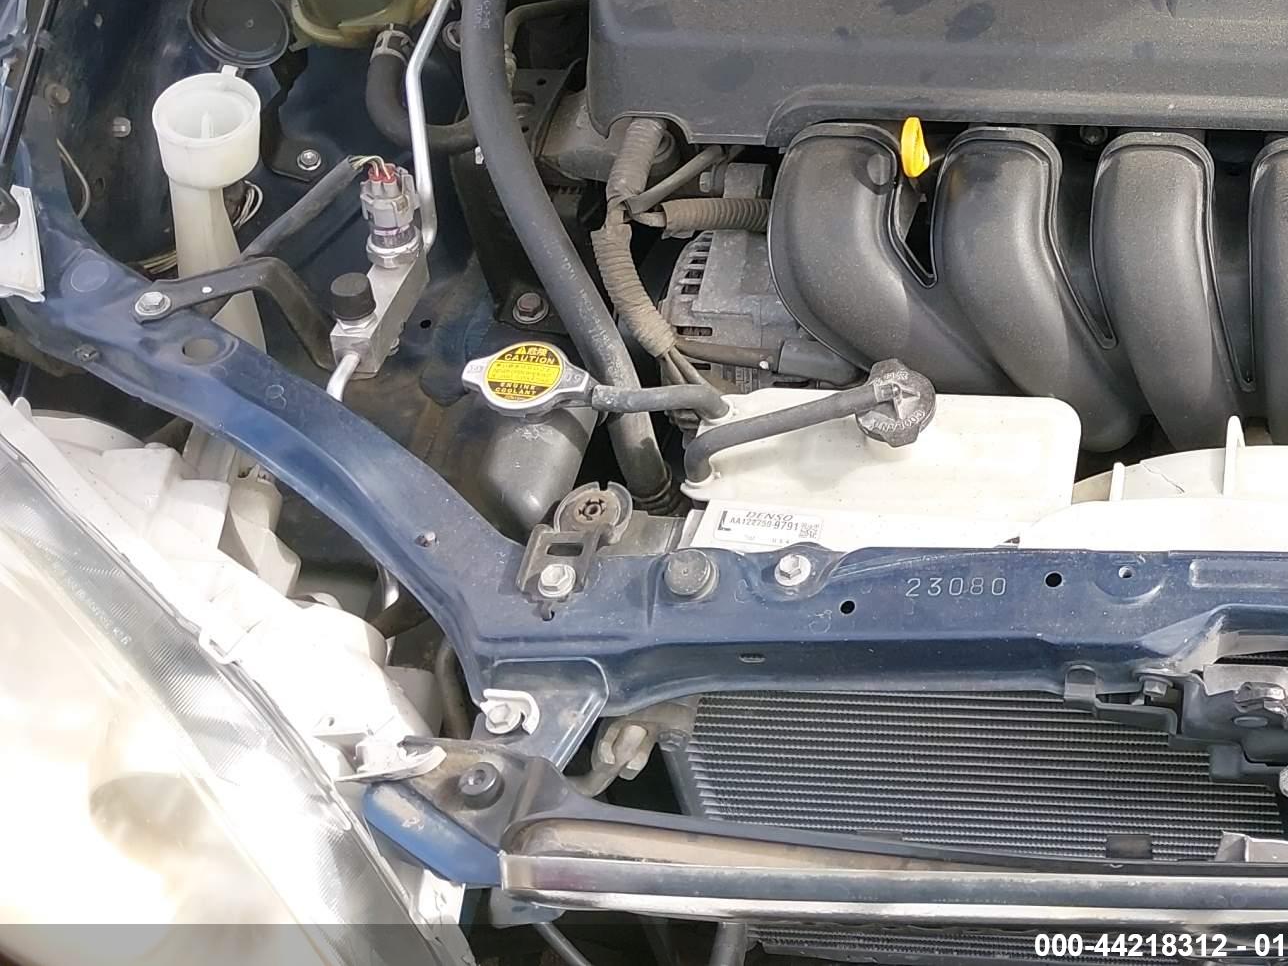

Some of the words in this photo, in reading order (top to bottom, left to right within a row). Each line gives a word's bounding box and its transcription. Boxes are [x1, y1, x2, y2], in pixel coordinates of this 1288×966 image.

[504, 354, 555, 364] CAUTION
[494, 387, 538, 396] COOLANT
[745, 510, 794, 522] DENSO
[905, 577, 1007, 597] 23080
